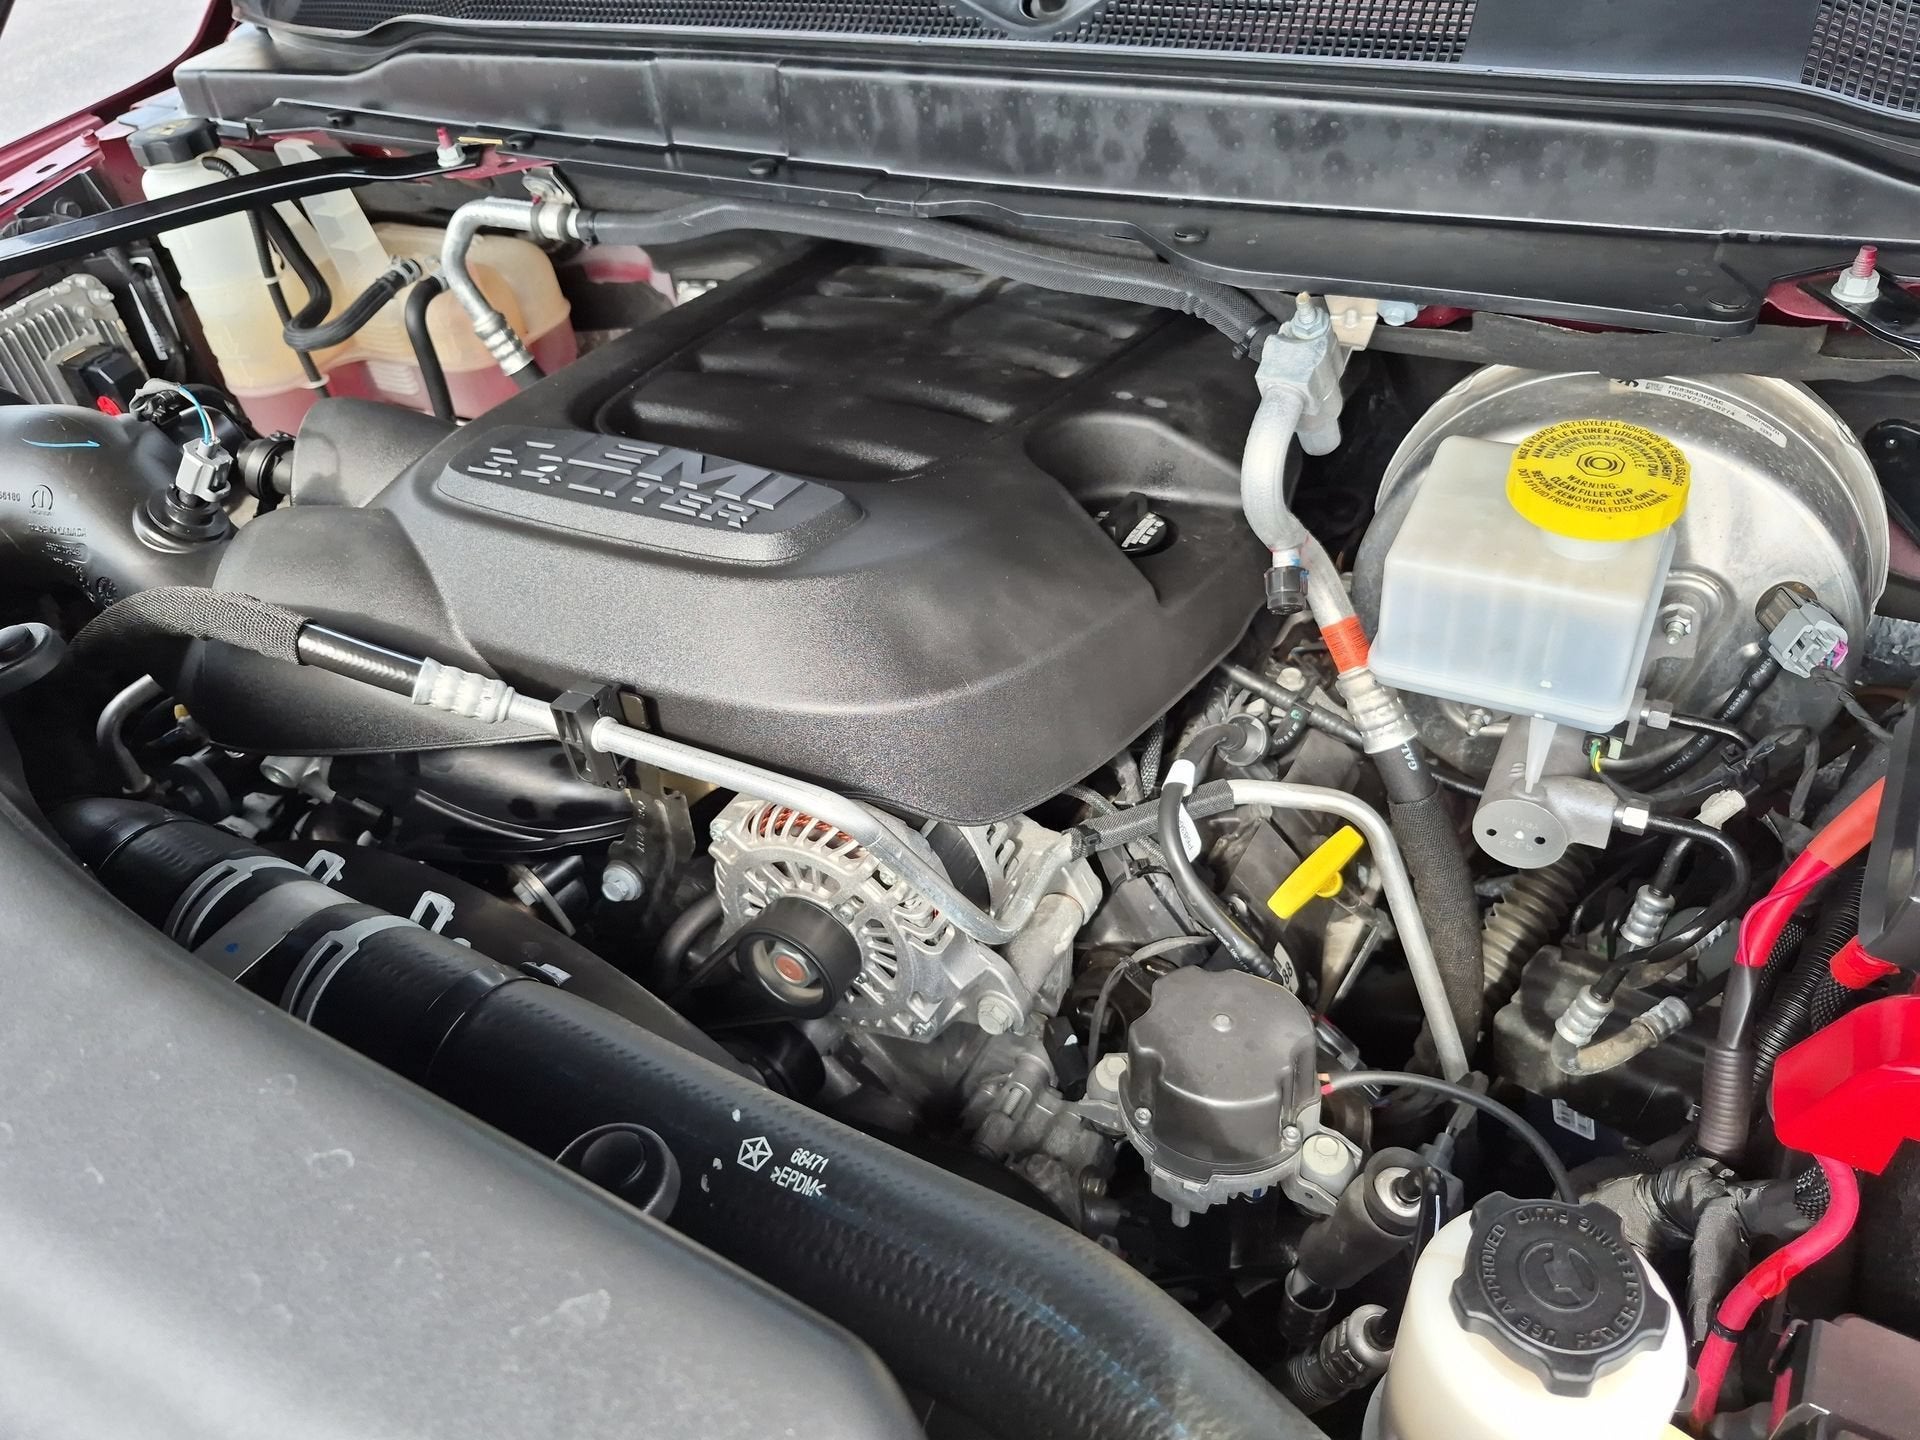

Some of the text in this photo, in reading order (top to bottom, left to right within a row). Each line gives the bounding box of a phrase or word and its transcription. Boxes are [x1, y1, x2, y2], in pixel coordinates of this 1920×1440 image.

[1531, 441, 1547, 458] AVANT
[1545, 435, 1559, 444] DE
[1557, 430, 1570, 439] LE
[1613, 429, 1653, 446] UTILISER
[1649, 445, 1673, 481] UNIQUEMENT
[1559, 420, 1607, 430] NETTOYER
[1609, 421, 1620, 429] LE
[1621, 423, 1662, 443] BOUCHON
[1661, 441, 1674, 450] DE
[1559, 441, 1618, 457] CONTENANT
[489, 431, 808, 511] HEMI
[1518, 468, 1531, 479] DOT
[1528, 483, 1550, 498] FLUID
[1547, 495, 1575, 508] FROM
[1584, 505, 1622, 513] SEALED
[1531, 470, 1558, 491] BEFORE
[1613, 497, 1633, 505] USE
[1634, 489, 1657, 501] ONLY
[1550, 476, 1633, 498] CLEAN FILLER CAP
[567, 465, 760, 530] LITER
[769, 1165, 827, 1197] >EPDM<
[790, 1147, 829, 1174] 66471
[1577, 1216, 1640, 1304] STEERING
[1480, 1224, 1558, 1346] USE APPROVED
[1576, 1305, 1638, 1349] POWER
